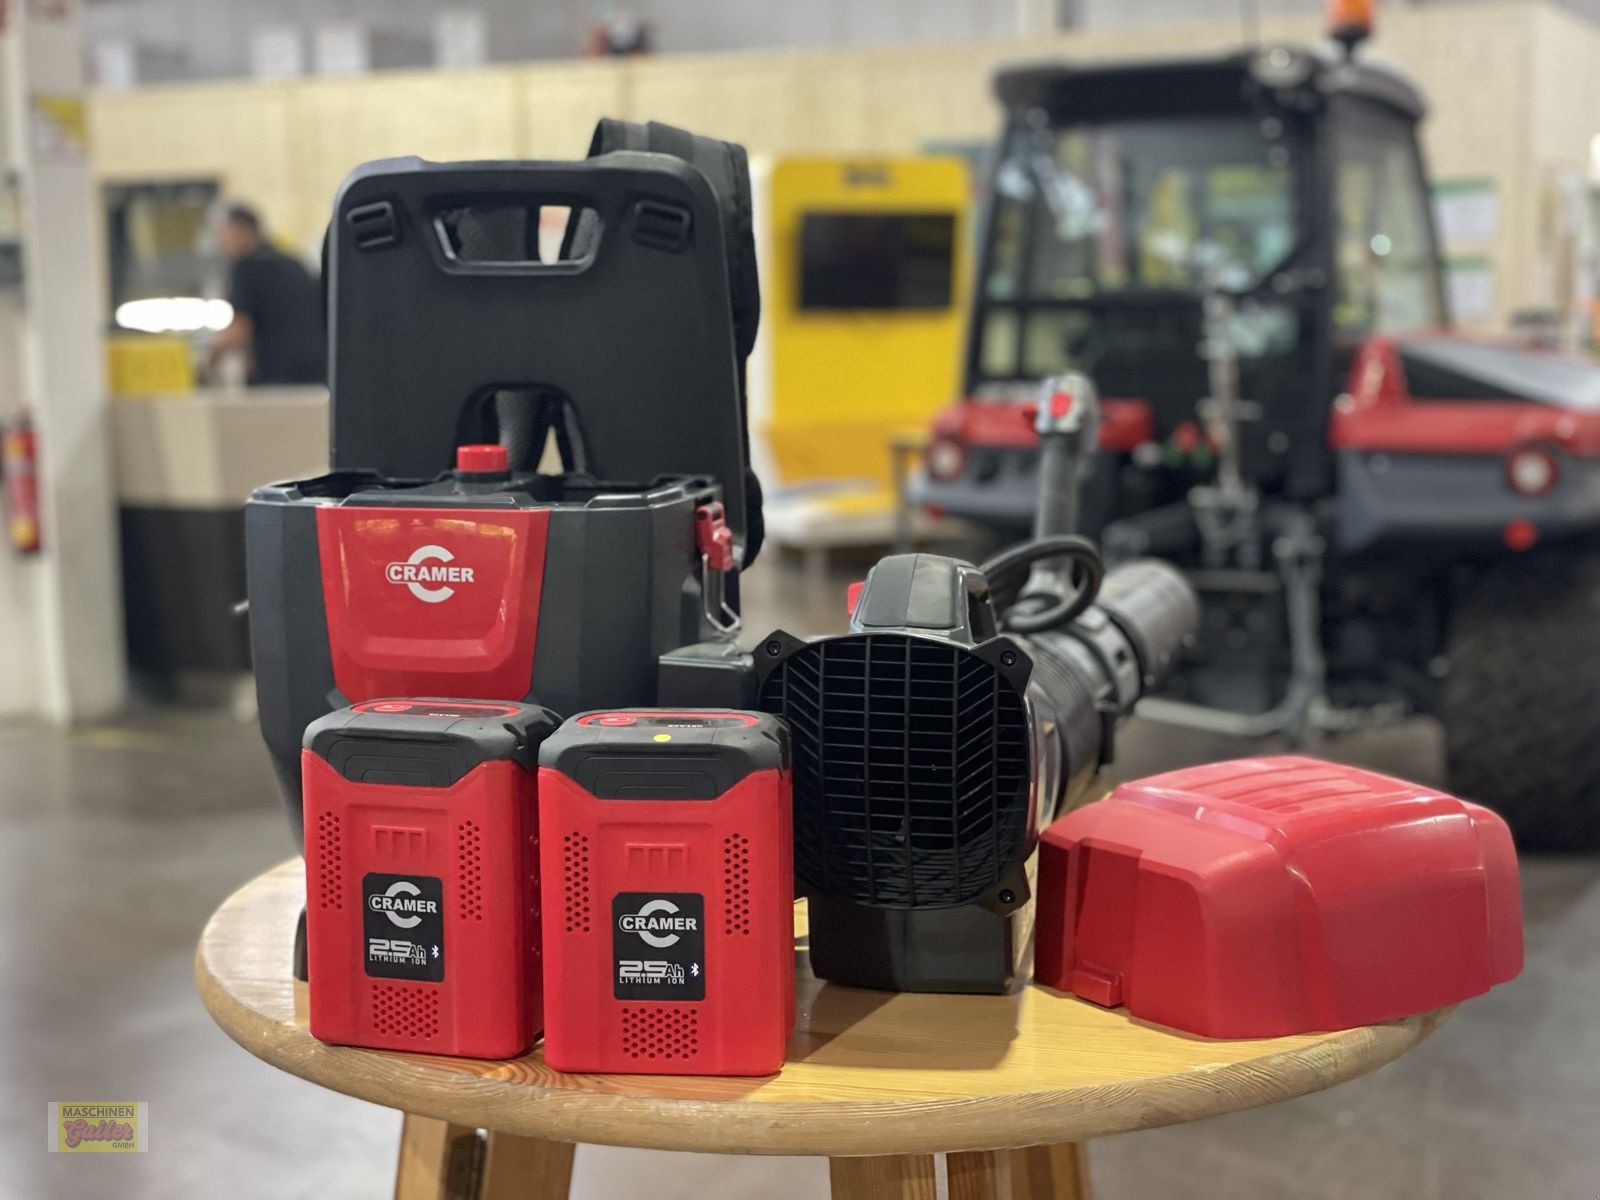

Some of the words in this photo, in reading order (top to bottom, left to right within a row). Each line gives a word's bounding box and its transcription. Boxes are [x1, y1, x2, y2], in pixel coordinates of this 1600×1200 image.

[389, 565, 475, 583] CRAMER
[371, 896, 437, 914] CRAMER
[622, 917, 698, 931] CRAMER
[369, 955, 406, 964] LITHIUM
[411, 958, 427, 966] ION
[619, 976, 661, 985] LITHIUM
[667, 977, 685, 985] ION
